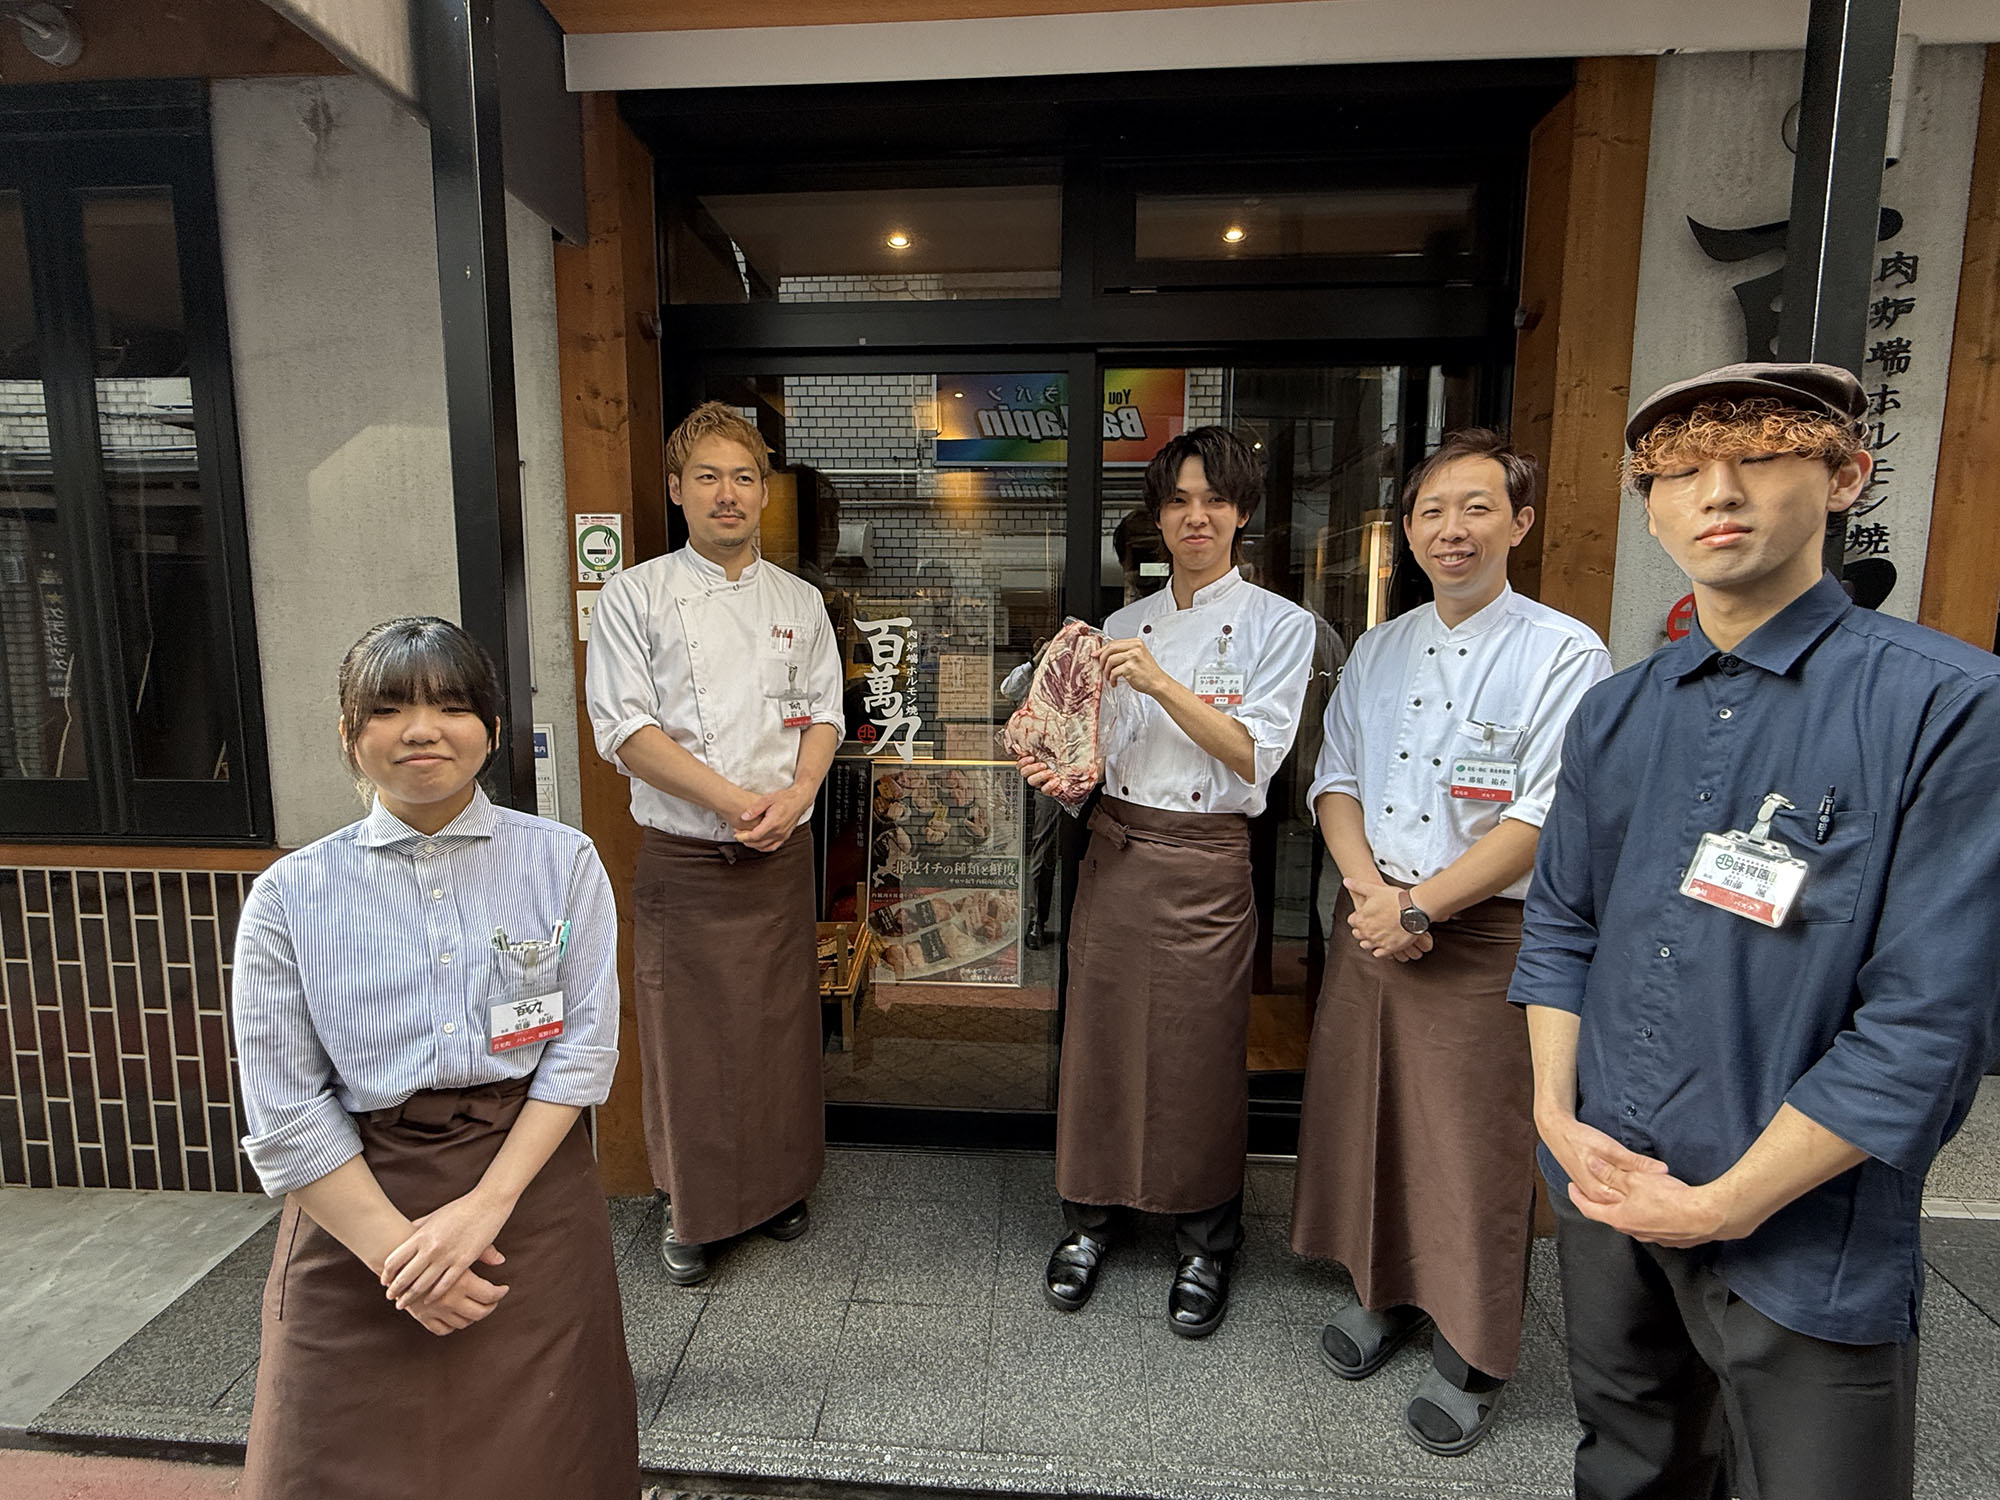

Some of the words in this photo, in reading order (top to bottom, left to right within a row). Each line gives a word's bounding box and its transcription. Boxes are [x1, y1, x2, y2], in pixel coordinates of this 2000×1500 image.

[594, 556, 606, 564] OK
[853, 616, 922, 763] 百萬力
[905, 628, 919, 716] 肉炉端ホルモン焼
